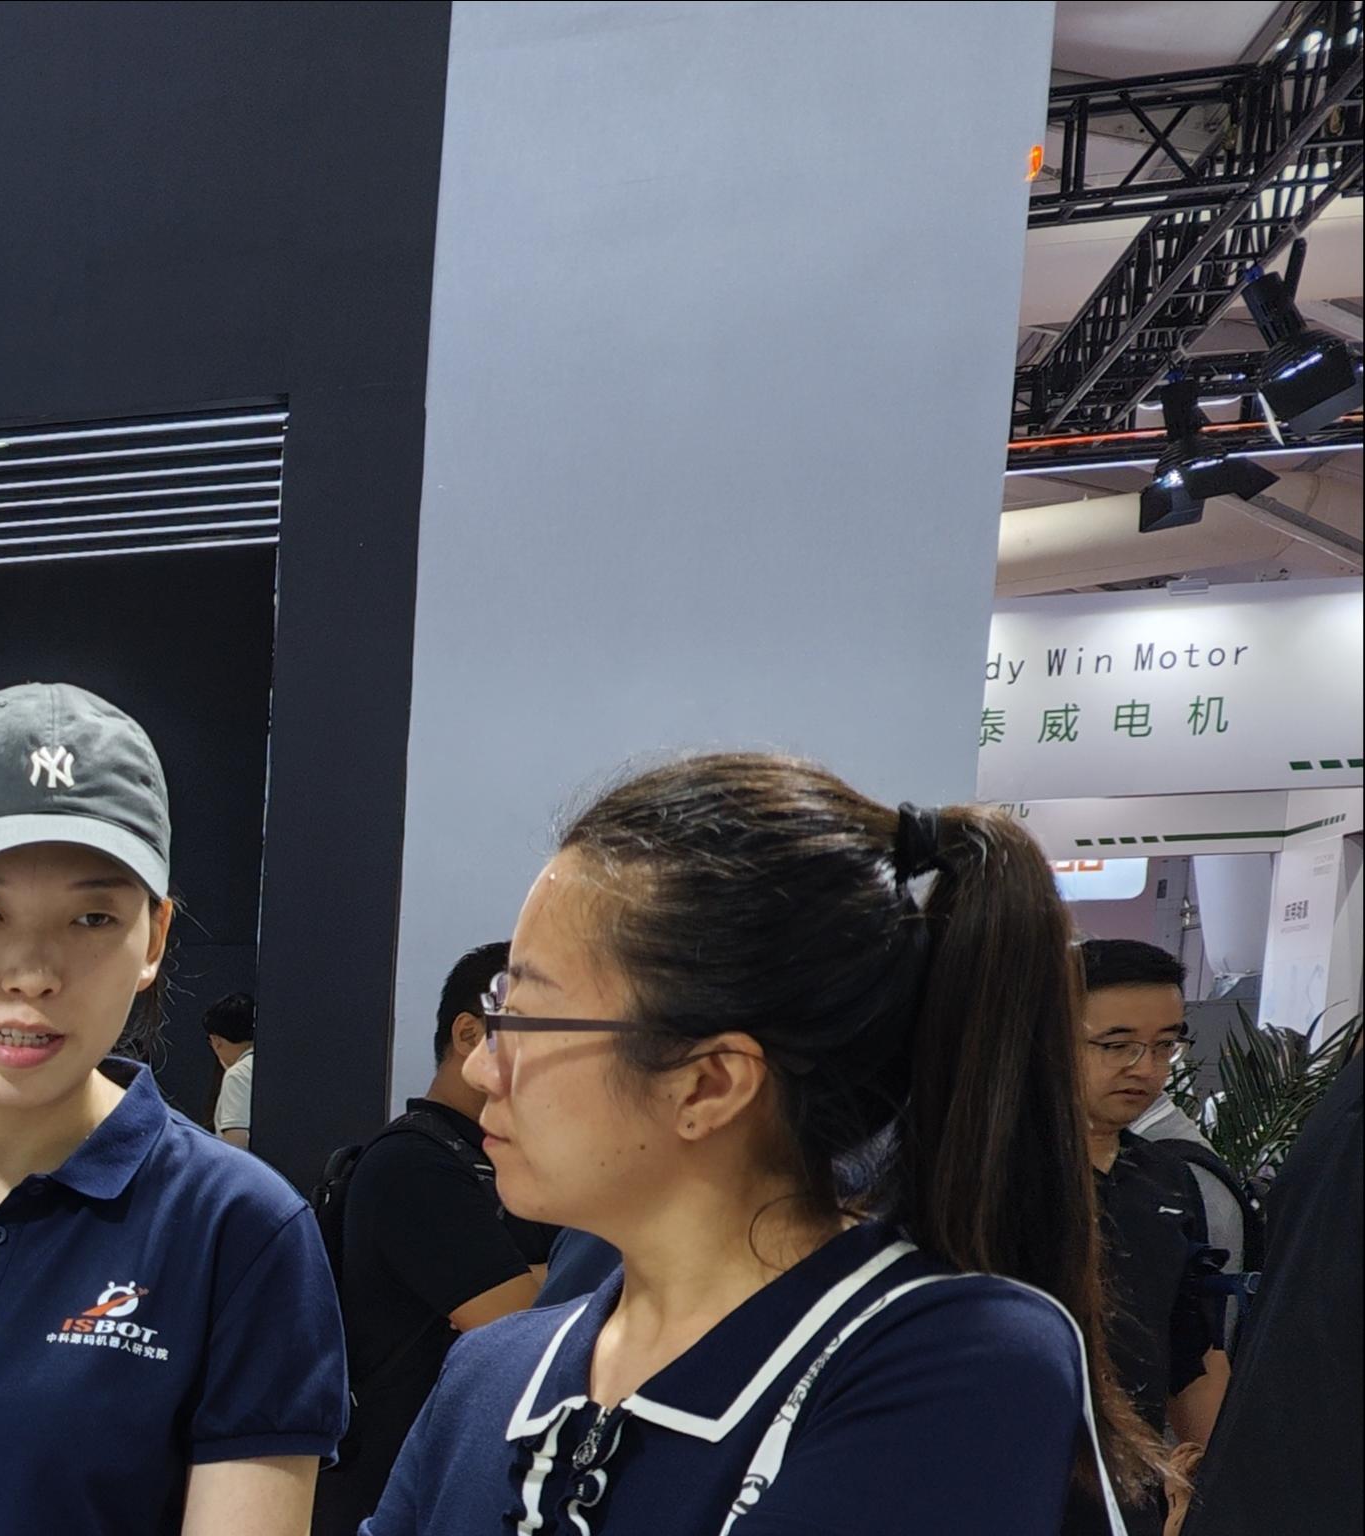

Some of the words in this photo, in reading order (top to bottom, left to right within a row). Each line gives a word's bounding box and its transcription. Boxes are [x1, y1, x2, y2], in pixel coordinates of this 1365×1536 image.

[1047, 648, 1113, 677] Win
[1134, 643, 1249, 671] Motor
[979, 695, 1229, 747] 泰威电机
[30, 745, 75, 788] NY
[46, 1332, 169, 1361] 中科源码机器人研究院
[62, 1318, 158, 1343] ISBOT
